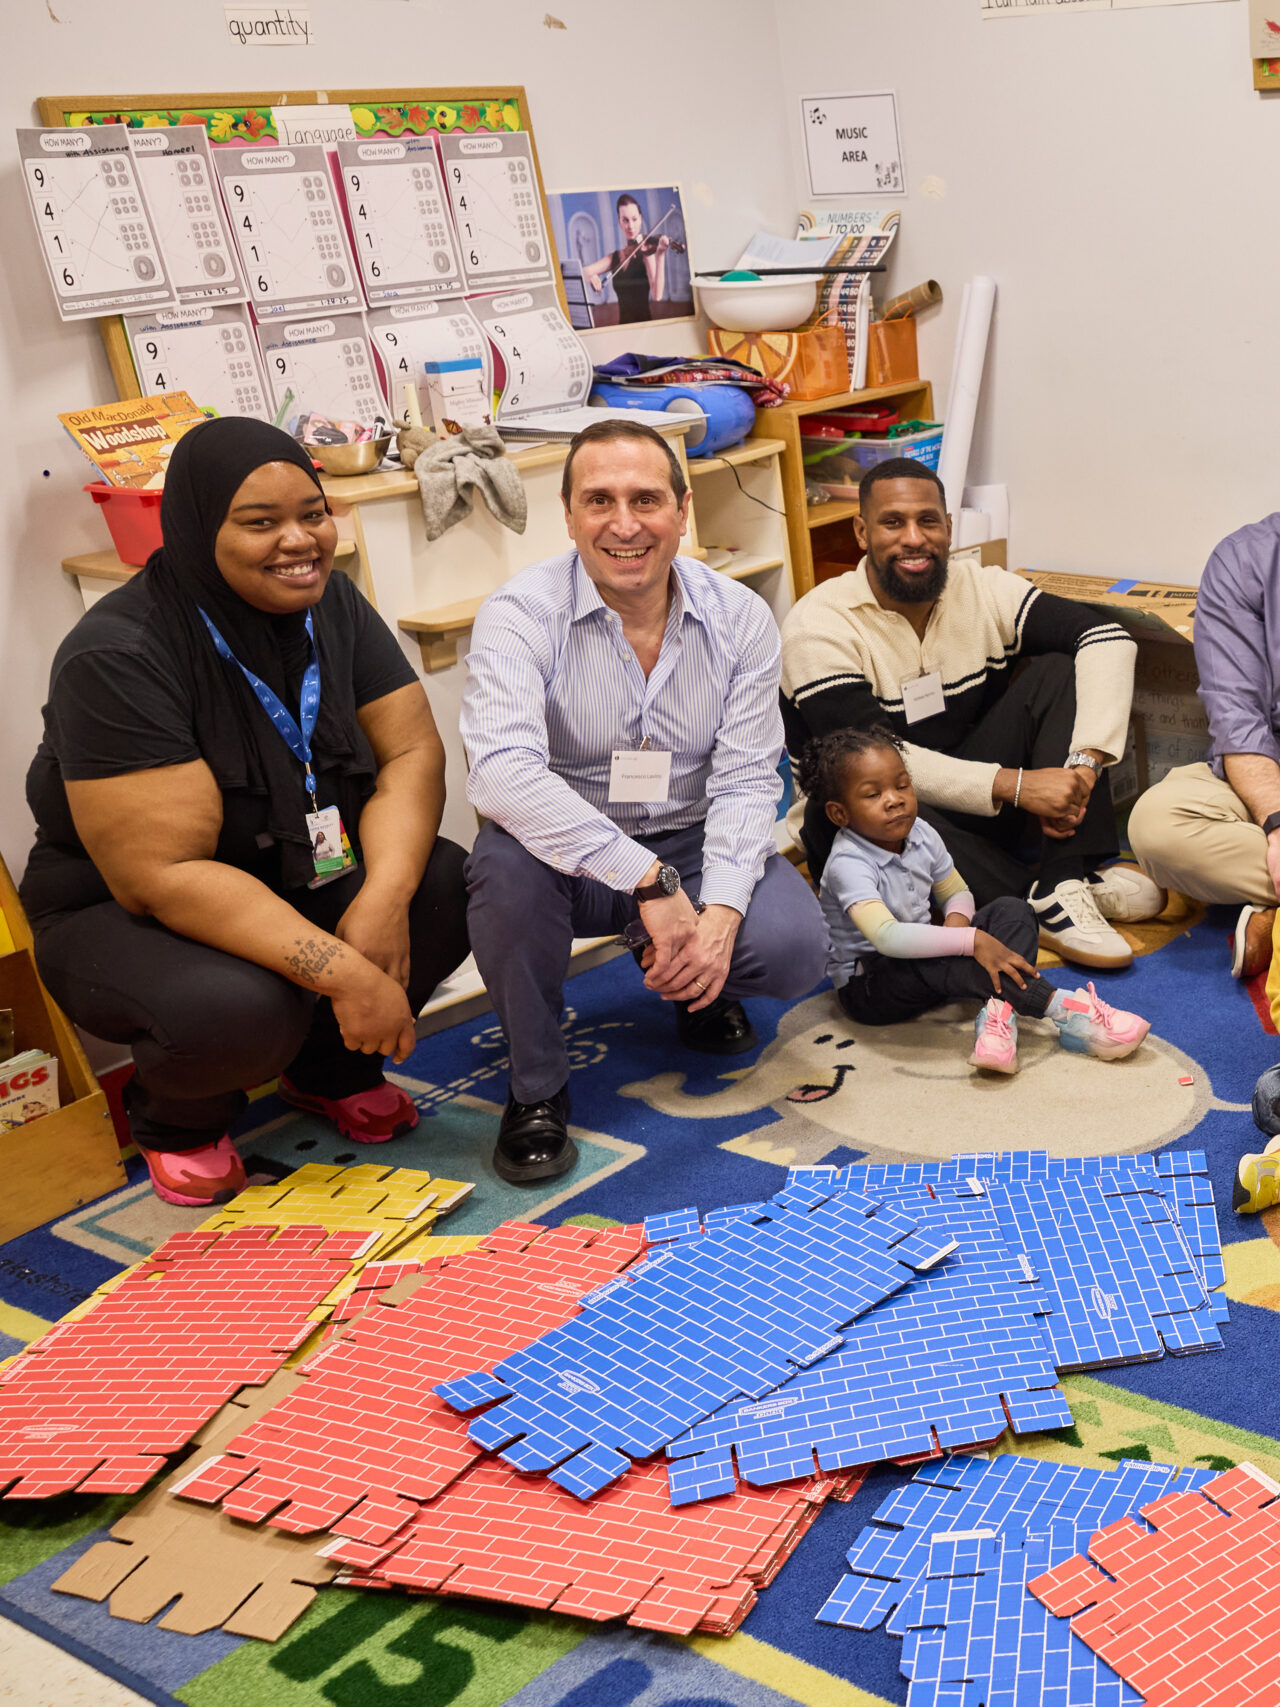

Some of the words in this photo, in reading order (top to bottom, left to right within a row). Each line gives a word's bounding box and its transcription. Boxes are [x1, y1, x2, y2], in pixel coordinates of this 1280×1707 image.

[229, 9, 313, 45] quantity.
[282, 120, 356, 145] Language
[836, 127, 868, 139] MUSIC
[44, 139, 59, 147] HOW
[60, 138, 84, 146] MANY?
[463, 142, 477, 150] HOW
[478, 141, 498, 149] MANY?
[247, 156, 264, 165] HOW
[266, 155, 290, 164] MANY?
[362, 149, 378, 157] HOW
[379, 147, 400, 156] MANY?
[842, 151, 868, 162] AREA
[34, 168, 45, 188] 9
[351, 175, 361, 191] 9
[453, 167, 461, 184] 9
[234, 185, 244, 202] 9
[44, 202, 54, 221] 4
[459, 196, 467, 211] 4
[359, 204, 367, 220] 4
[827, 212, 872, 223] NUMBERS
[243, 216, 252, 232] 4
[466, 223, 473, 239] 1
[835, 225, 847, 234] TO
[850, 224, 864, 234] 100
[54, 236, 63, 253] 1
[366, 233, 373, 248] 1
[251, 246, 259, 261] 1
[470, 250, 479, 266] 6
[63, 268, 75, 286] 6
[371, 261, 381, 277] 6
[258, 275, 268, 292] 6
[162, 310, 181, 321] HOW
[182, 308, 208, 320] MANY?
[289, 329, 306, 338] HOW
[307, 326, 330, 336] MANY?
[385, 332, 398, 346] 9
[494, 325, 506, 338] 9
[146, 342, 158, 360] 9
[512, 347, 522, 360] 4
[276, 358, 286, 375] 9
[399, 357, 409, 373] 4
[155, 373, 166, 390] 4
[519, 371, 525, 385] 1
[510, 394, 520, 406] 6
[69, 412, 91, 426] Old
[92, 403, 154, 421] MacDonald
[82, 424, 167, 450] Woodshop
